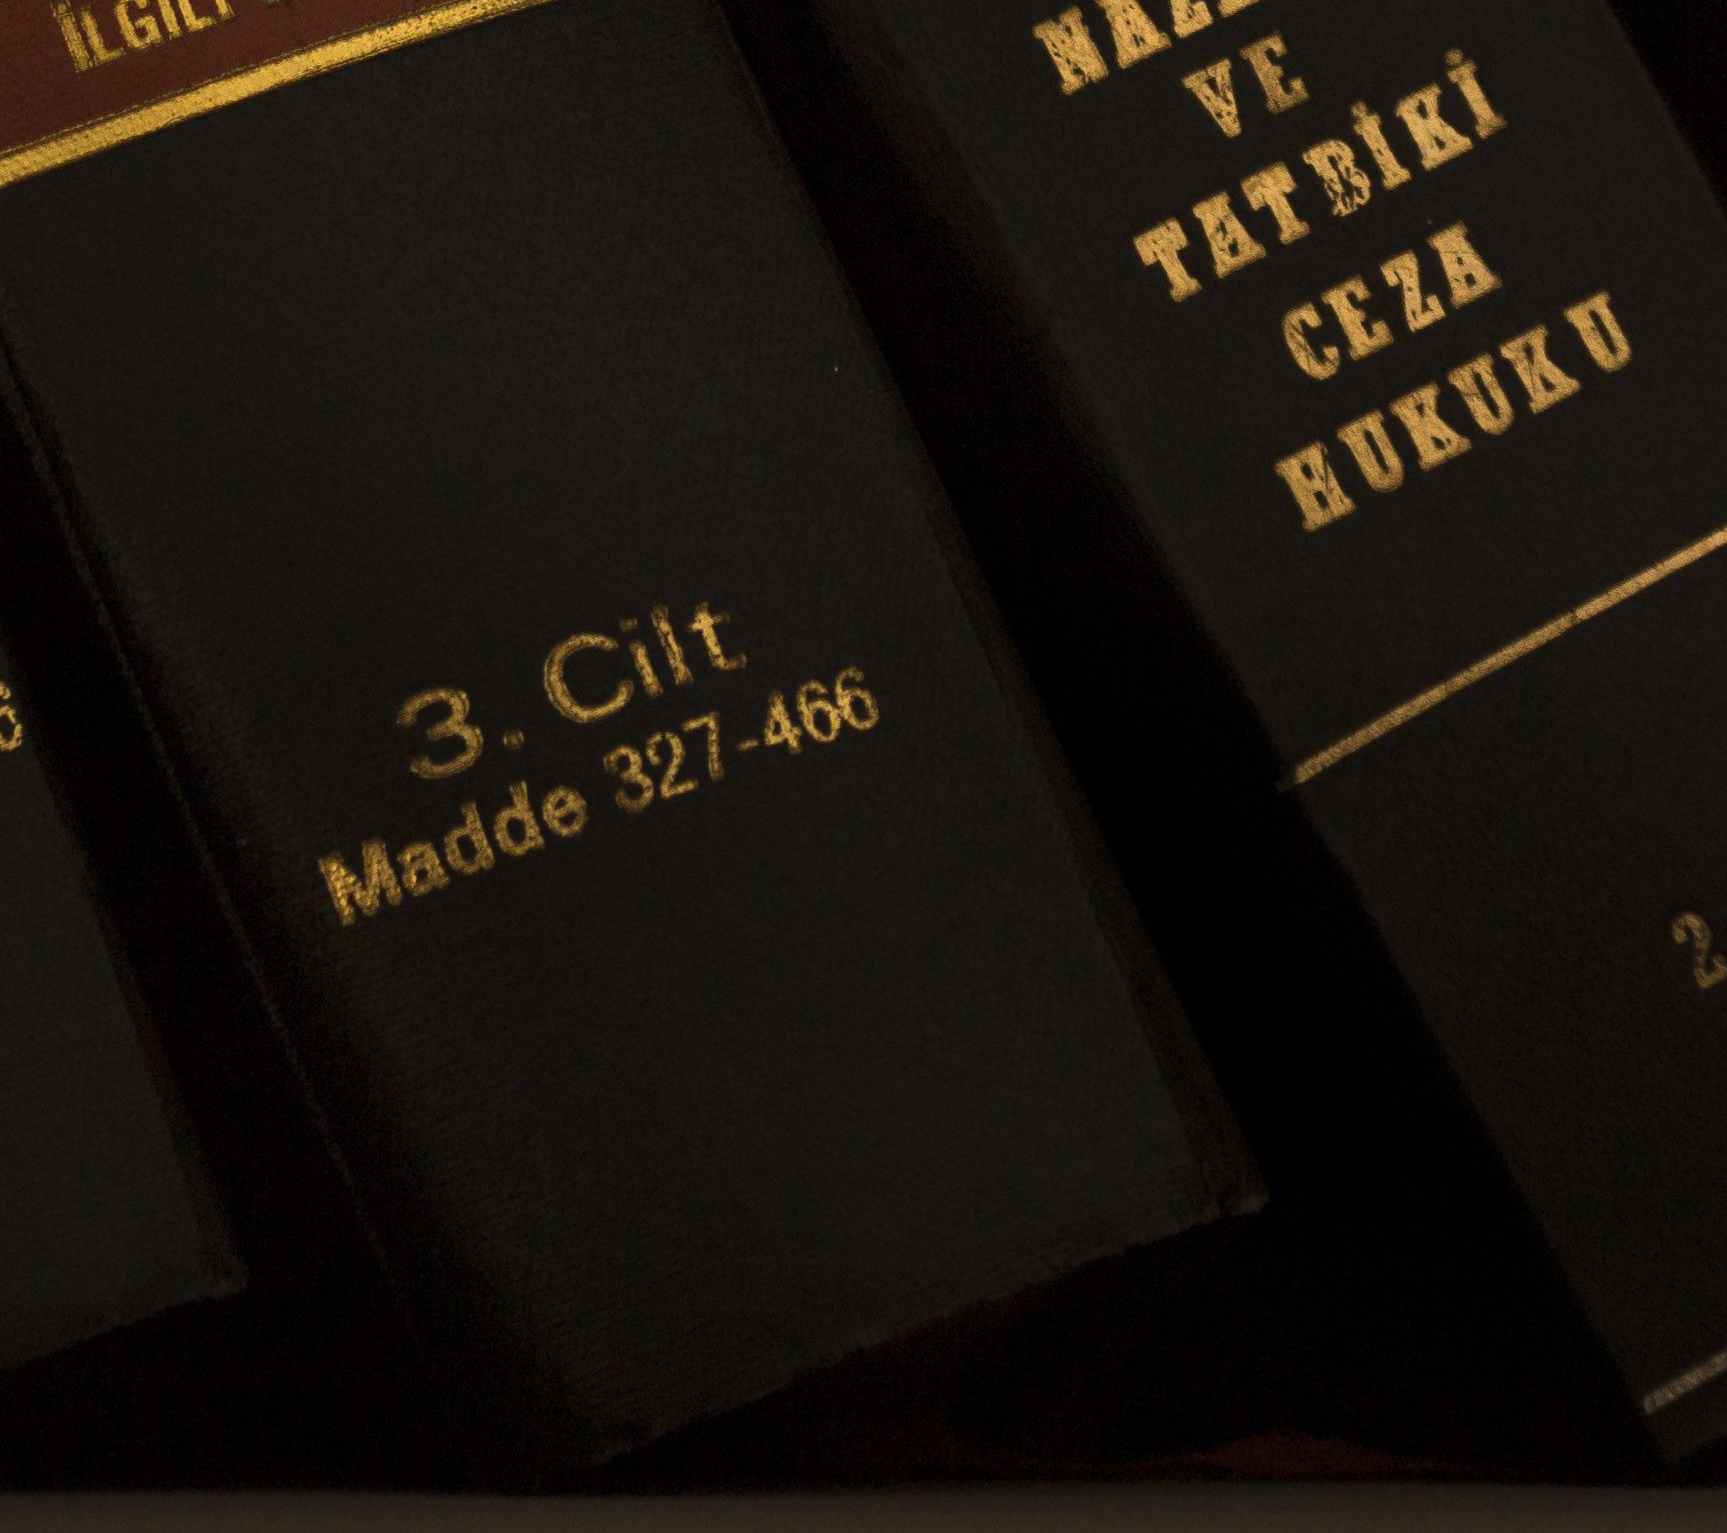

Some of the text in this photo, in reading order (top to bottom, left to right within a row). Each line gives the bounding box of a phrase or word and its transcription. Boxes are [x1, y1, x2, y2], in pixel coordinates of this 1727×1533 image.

[1133, 48, 1508, 302] TATBİKİ
[1181, 32, 1310, 138] VE
[1281, 221, 1503, 380] CEZA
[1274, 290, 1633, 533] HUKUKU
[317, 666, 880, 926] Madde 327-466
[395, 601, 748, 780] 3. Cilt
